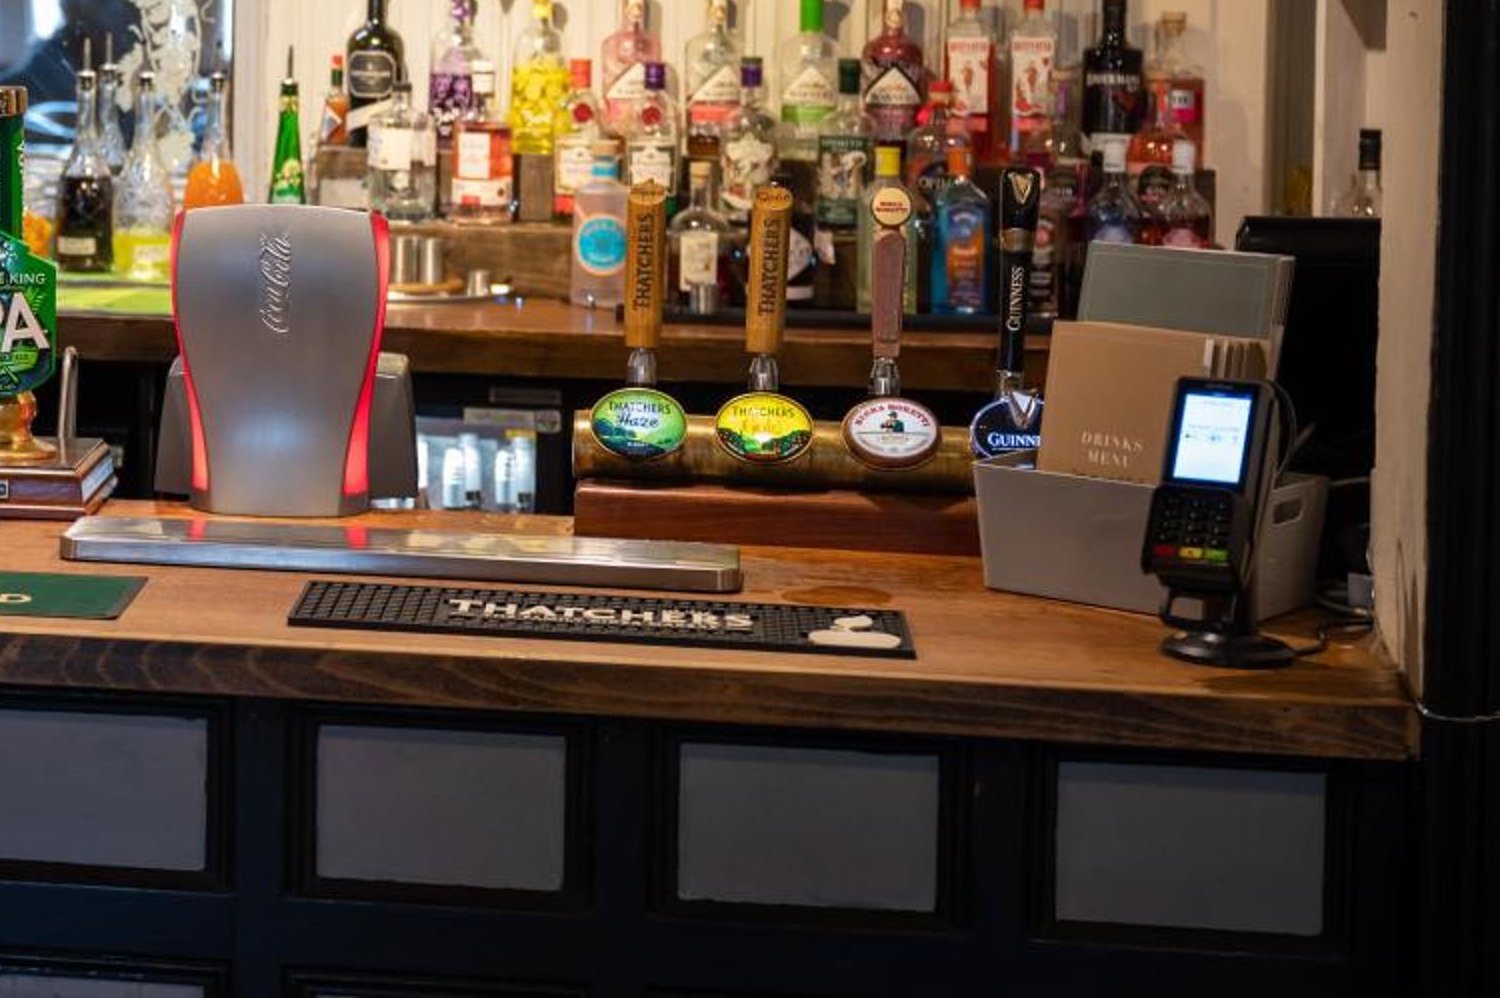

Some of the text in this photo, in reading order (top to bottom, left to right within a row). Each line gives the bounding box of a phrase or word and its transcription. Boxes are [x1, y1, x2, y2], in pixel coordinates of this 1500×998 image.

[632, 213, 653, 312] THATCHERS
[758, 218, 781, 317] THATCHERS
[10, 272, 46, 285] KING
[1006, 265, 1026, 332] GUINNESS
[608, 401, 672, 415] THATCHERS
[732, 405, 796, 419] THATCHERS
[1081, 430, 1143, 453] DRINKS
[1088, 450, 1131, 469] MENU
[450, 598, 753, 630] THATCHERS
